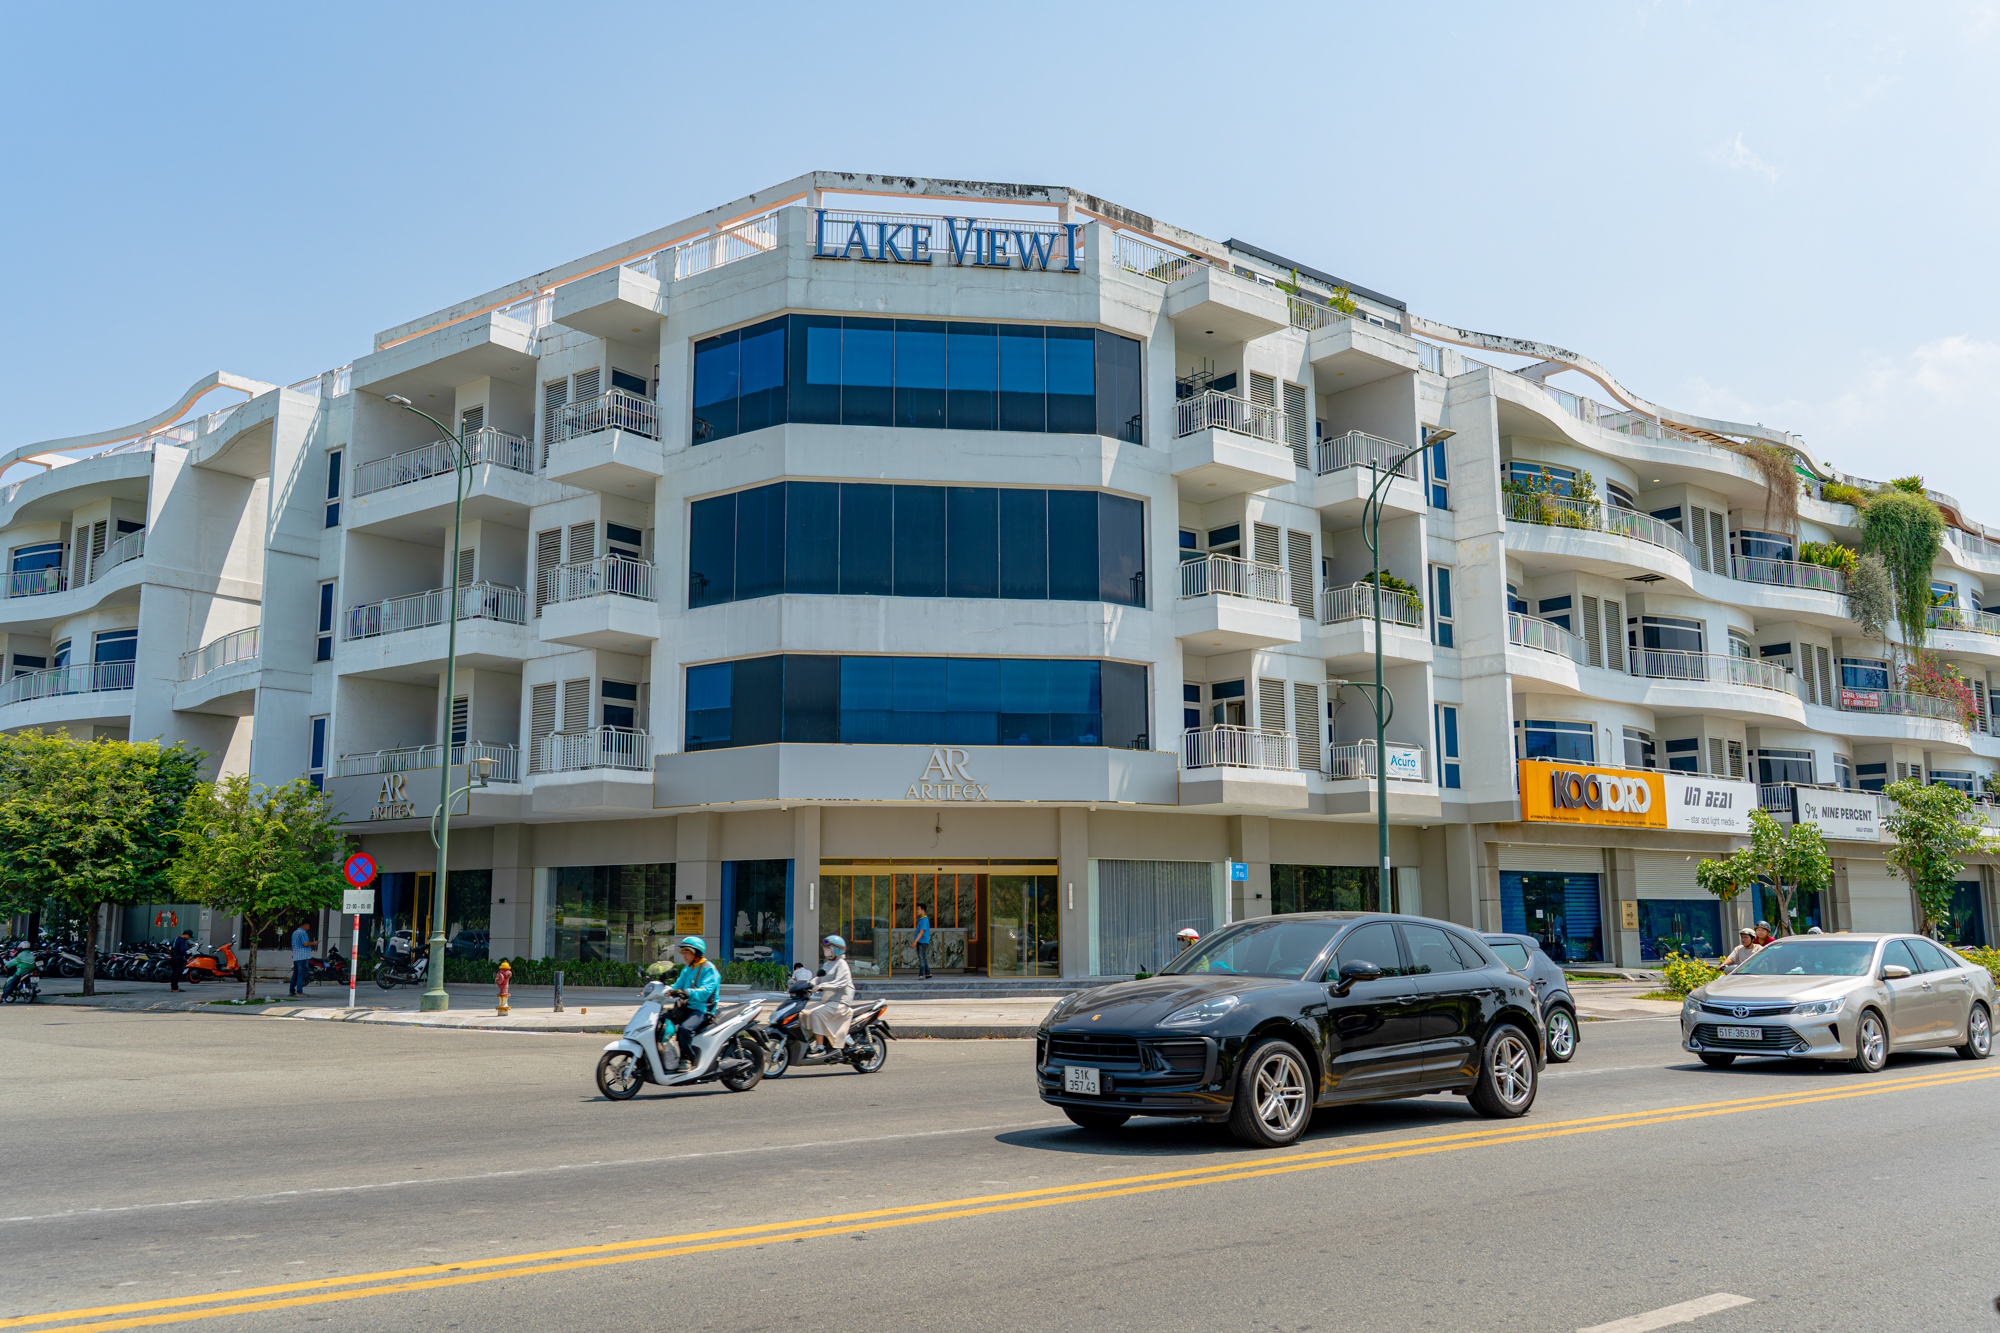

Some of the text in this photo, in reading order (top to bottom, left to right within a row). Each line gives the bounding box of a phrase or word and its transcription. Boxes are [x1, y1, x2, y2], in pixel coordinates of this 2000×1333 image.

[813, 209, 932, 264] LAKE
[919, 748, 975, 782] AR
[1390, 754, 1416, 768] Acuro
[376, 773, 406, 803] AR
[905, 783, 989, 800] ARTIFEX
[370, 803, 415, 820] ARTIFEX
[1804, 802, 1872, 821] 9% NINE PERCENT
[1701, 816, 1710, 824] and
[1710, 816, 1720, 826] light
[1721, 818, 1734, 826] media
[1075, 1069, 1089, 1080] 51K
[1069, 1080, 1096, 1092] 357.43
